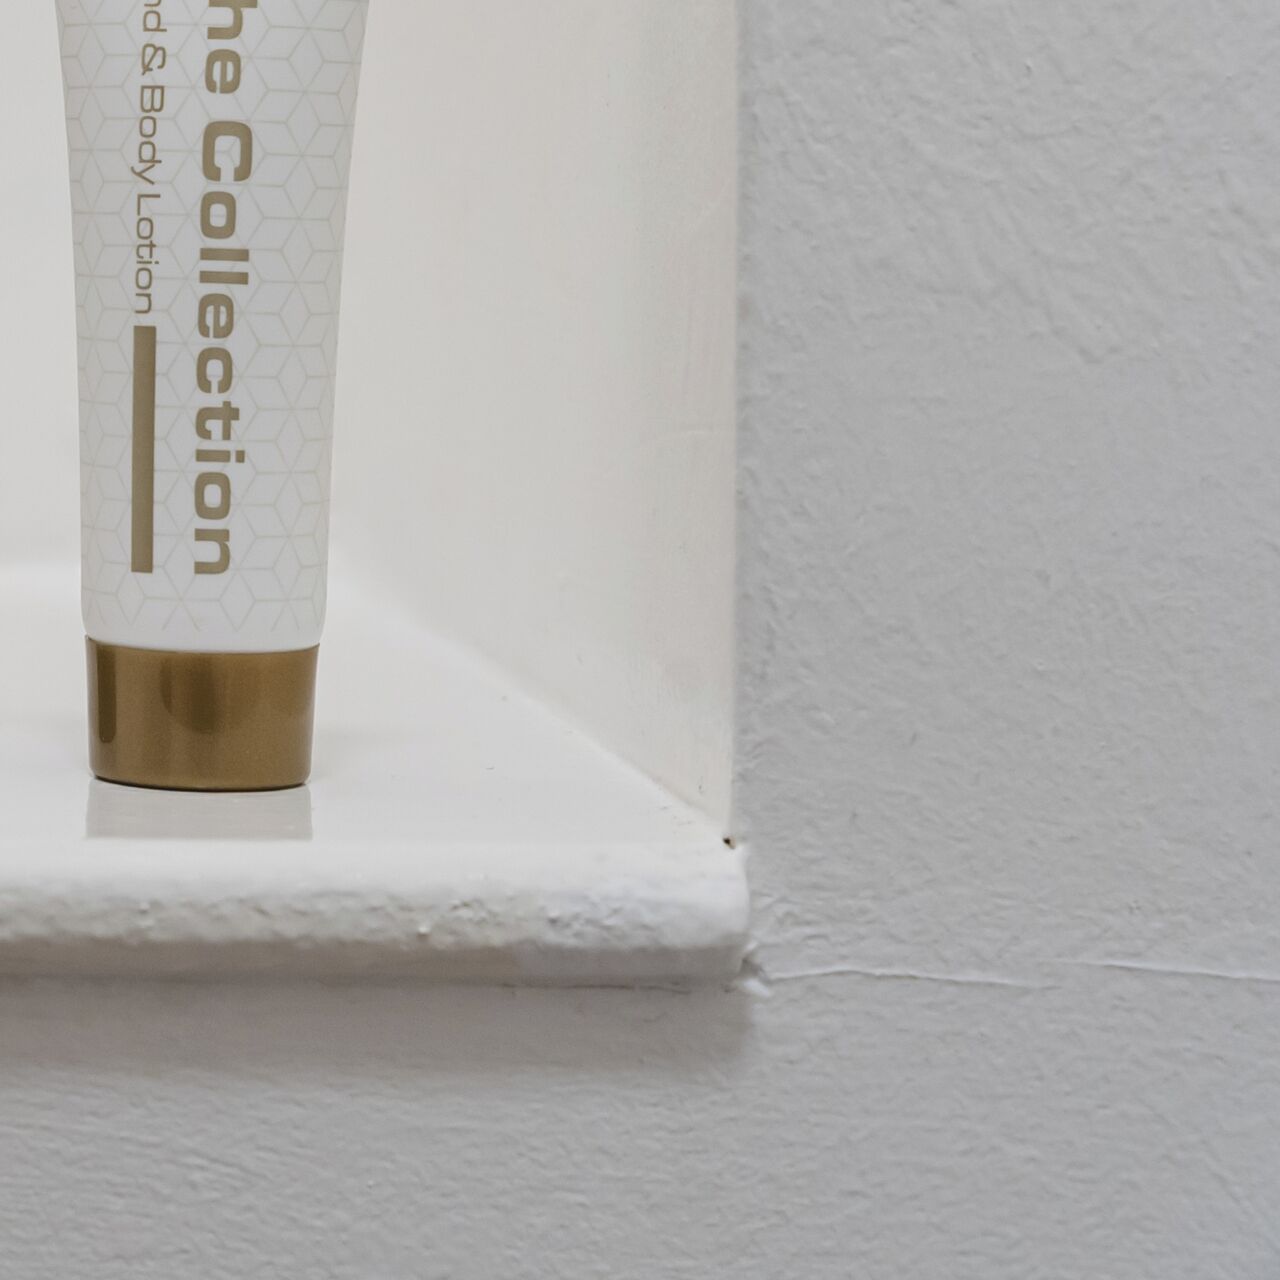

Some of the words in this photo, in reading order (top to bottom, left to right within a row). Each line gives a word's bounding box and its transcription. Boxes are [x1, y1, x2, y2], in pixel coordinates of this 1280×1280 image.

[140, 42, 167, 76] &
[130, 84, 166, 186] Body
[133, 193, 162, 315] Lotion
[193, 119, 254, 576] Collection
